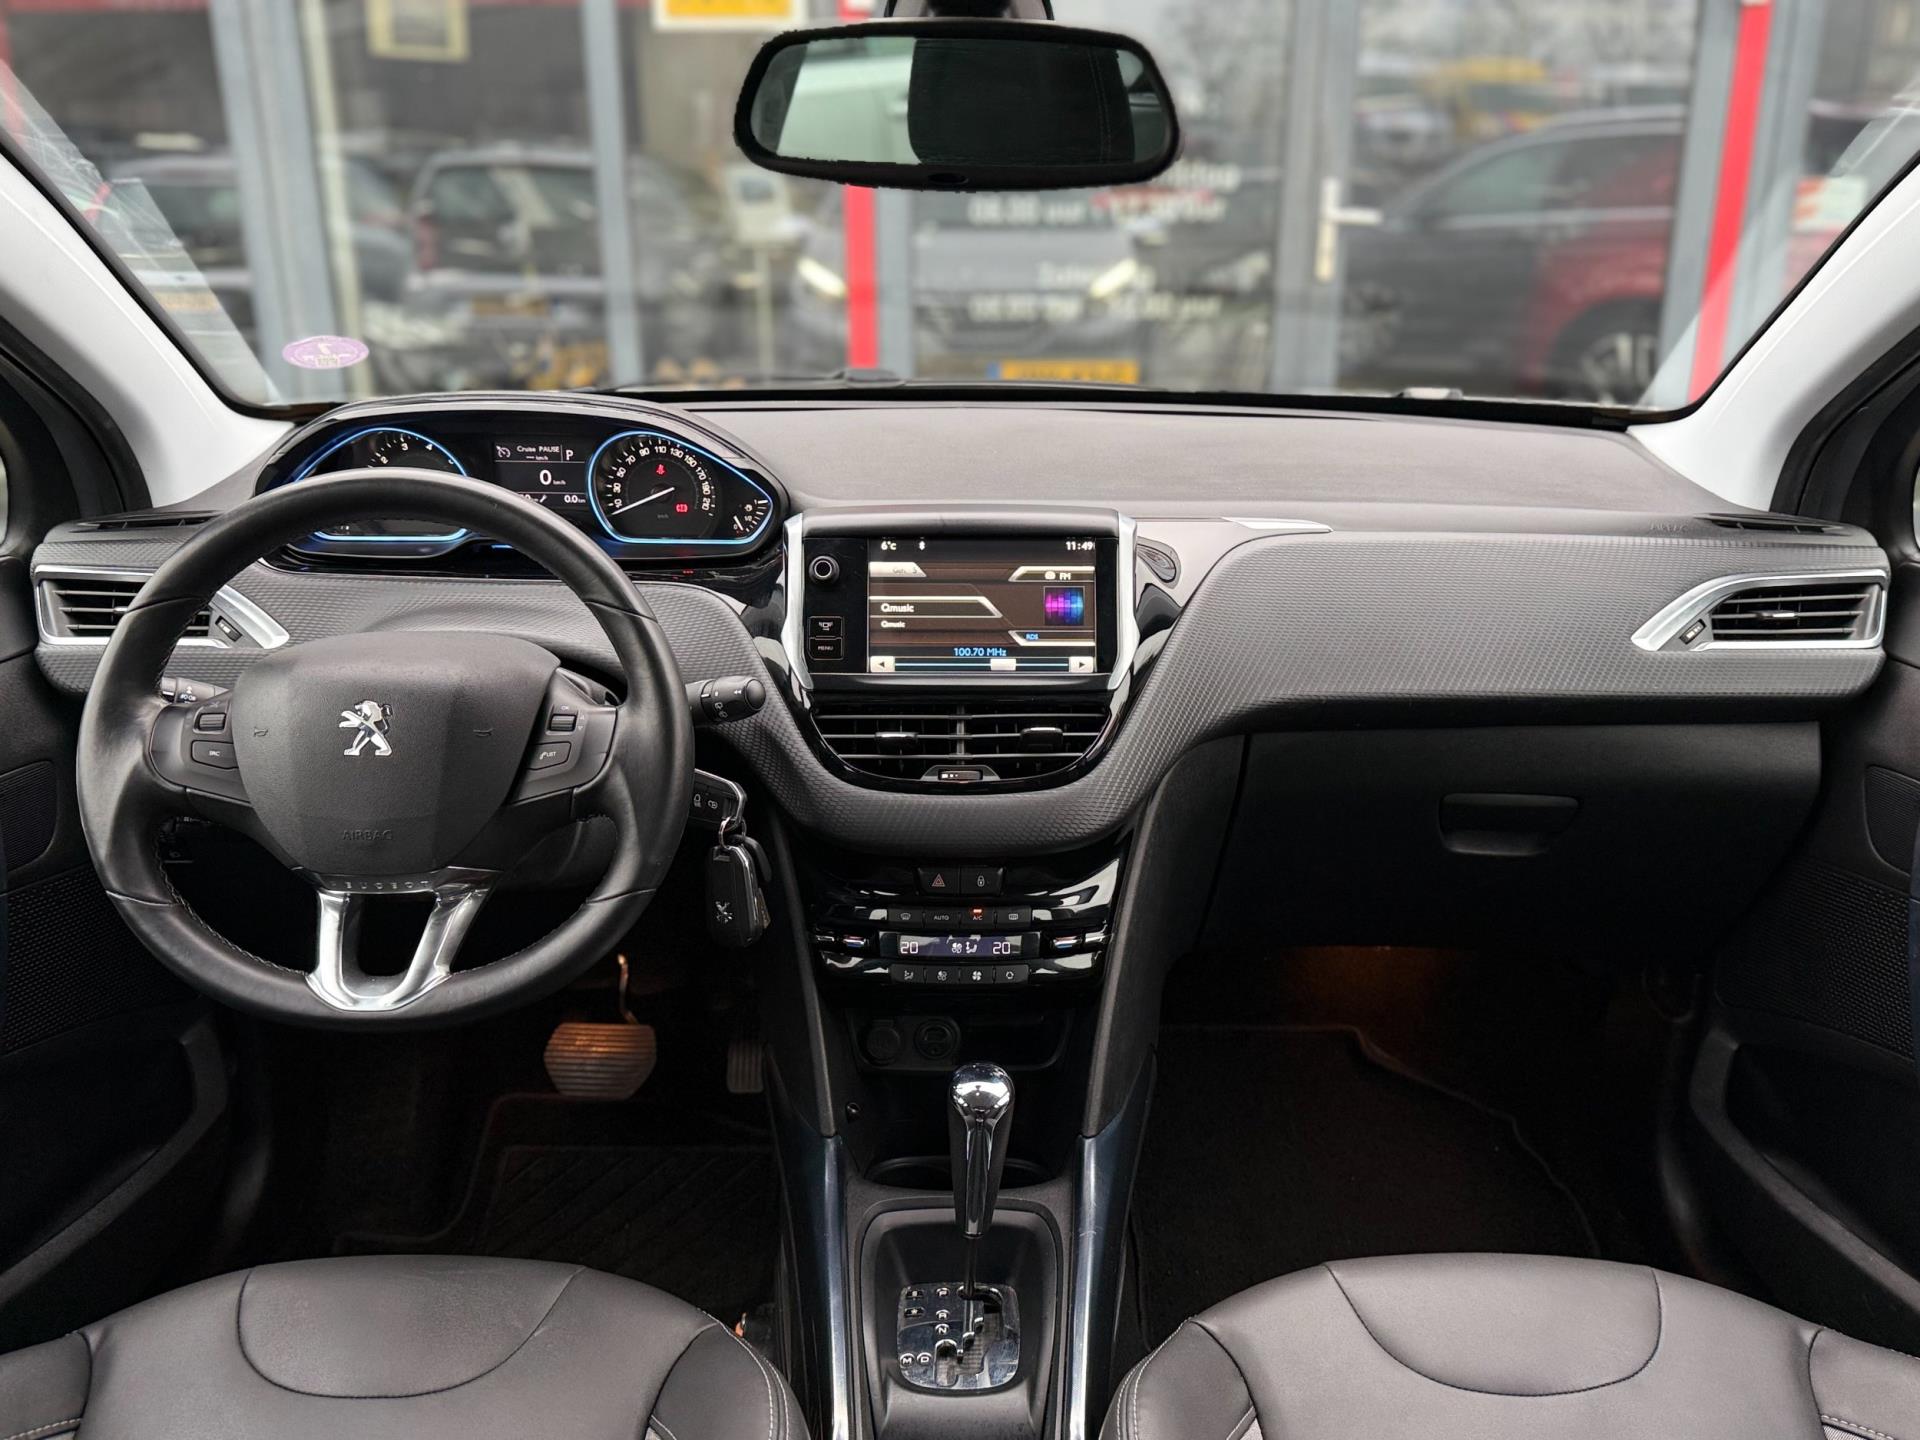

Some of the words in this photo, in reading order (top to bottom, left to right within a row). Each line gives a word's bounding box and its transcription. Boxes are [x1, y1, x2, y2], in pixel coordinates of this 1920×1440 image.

[401, 442, 409, 451] 3
[425, 443, 433, 451] 4
[516, 445, 537, 453] Cruise
[538, 445, 560, 453] PAUSE
[639, 447, 651, 457] 90
[654, 445, 668, 454] 110
[565, 449, 574, 461] P
[670, 447, 685, 459] 130
[380, 456, 389, 465] 2
[625, 454, 637, 465] 70
[683, 454, 698, 468] 150
[539, 469, 552, 485] 0
[616, 466, 627, 478] 50
[695, 466, 707, 481] 170
[612, 482, 622, 493] 30
[701, 481, 711, 495] 190
[701, 497, 711, 511] 210
[1065, 540, 1094, 551] 11:49
[1059, 572, 1072, 580] FM
[880, 602, 915, 613] Qmusic
[953, 647, 985, 657] 100.70
[986, 647, 1007, 657] MHz
[343, 829, 393, 841] AIRBAG
[900, 941, 919, 955] 20
[992, 941, 1011, 955] 20
[902, 1356, 912, 1364] M
